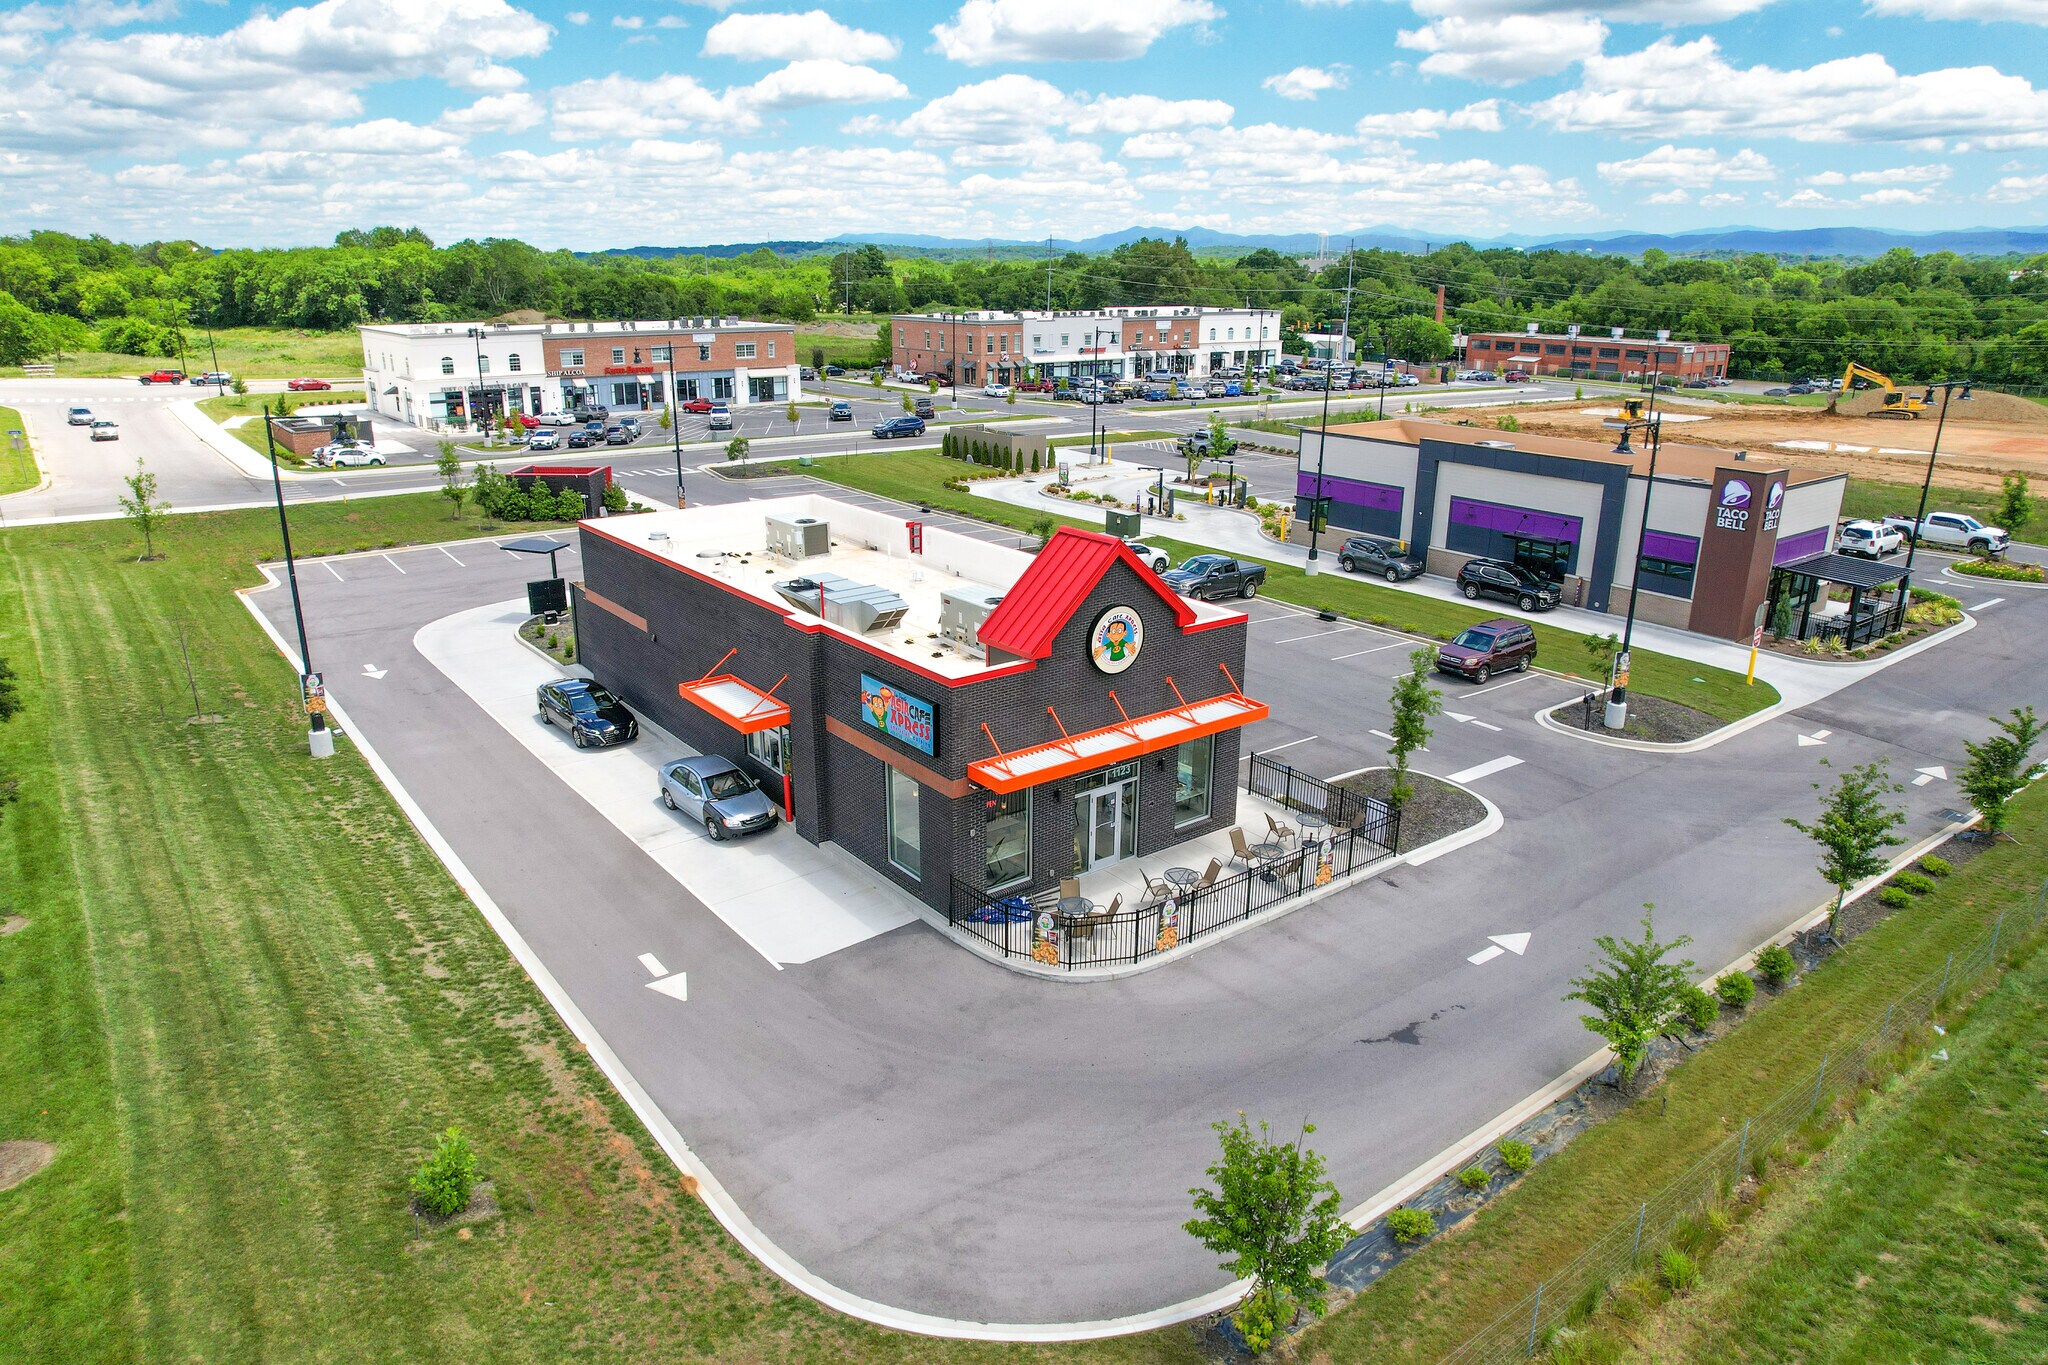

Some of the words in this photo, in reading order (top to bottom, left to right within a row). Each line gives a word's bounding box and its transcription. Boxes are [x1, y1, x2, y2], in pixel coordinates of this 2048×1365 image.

[1716, 506, 1749, 521] TACO
[1765, 509, 1780, 521] TACO
[1716, 518, 1746, 531] BELL
[1763, 519, 1778, 531] BELL
[1112, 764, 1131, 778] 1123
